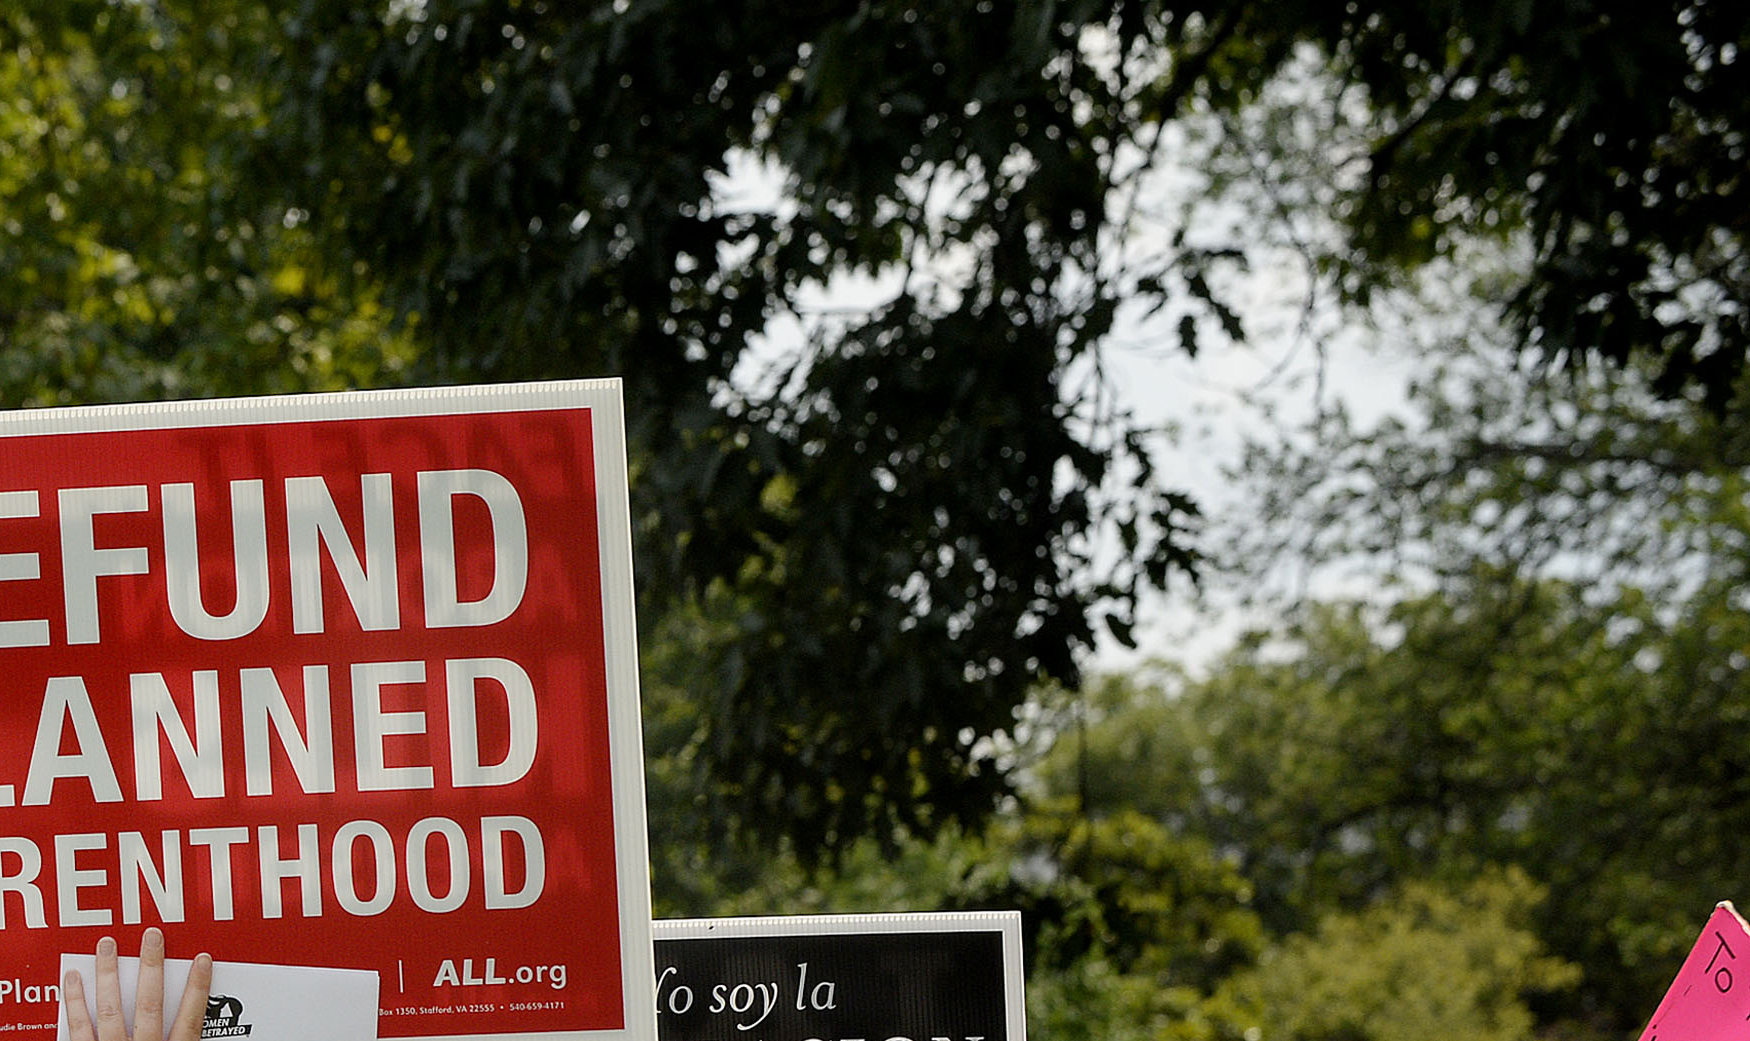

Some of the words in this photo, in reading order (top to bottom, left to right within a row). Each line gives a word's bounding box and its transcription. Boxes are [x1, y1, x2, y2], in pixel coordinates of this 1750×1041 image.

[433, 958, 567, 990] ALL.org
[710, 982, 778, 1030] soy
[796, 963, 836, 1011] la
[456, 1005, 468, 1013] VA
[469, 1004, 495, 1013] 22555
[17, 1022, 43, 1031] Brown
[202, 1018, 230, 1028] OMEN
[201, 1026, 246, 1037] BETRAYED
